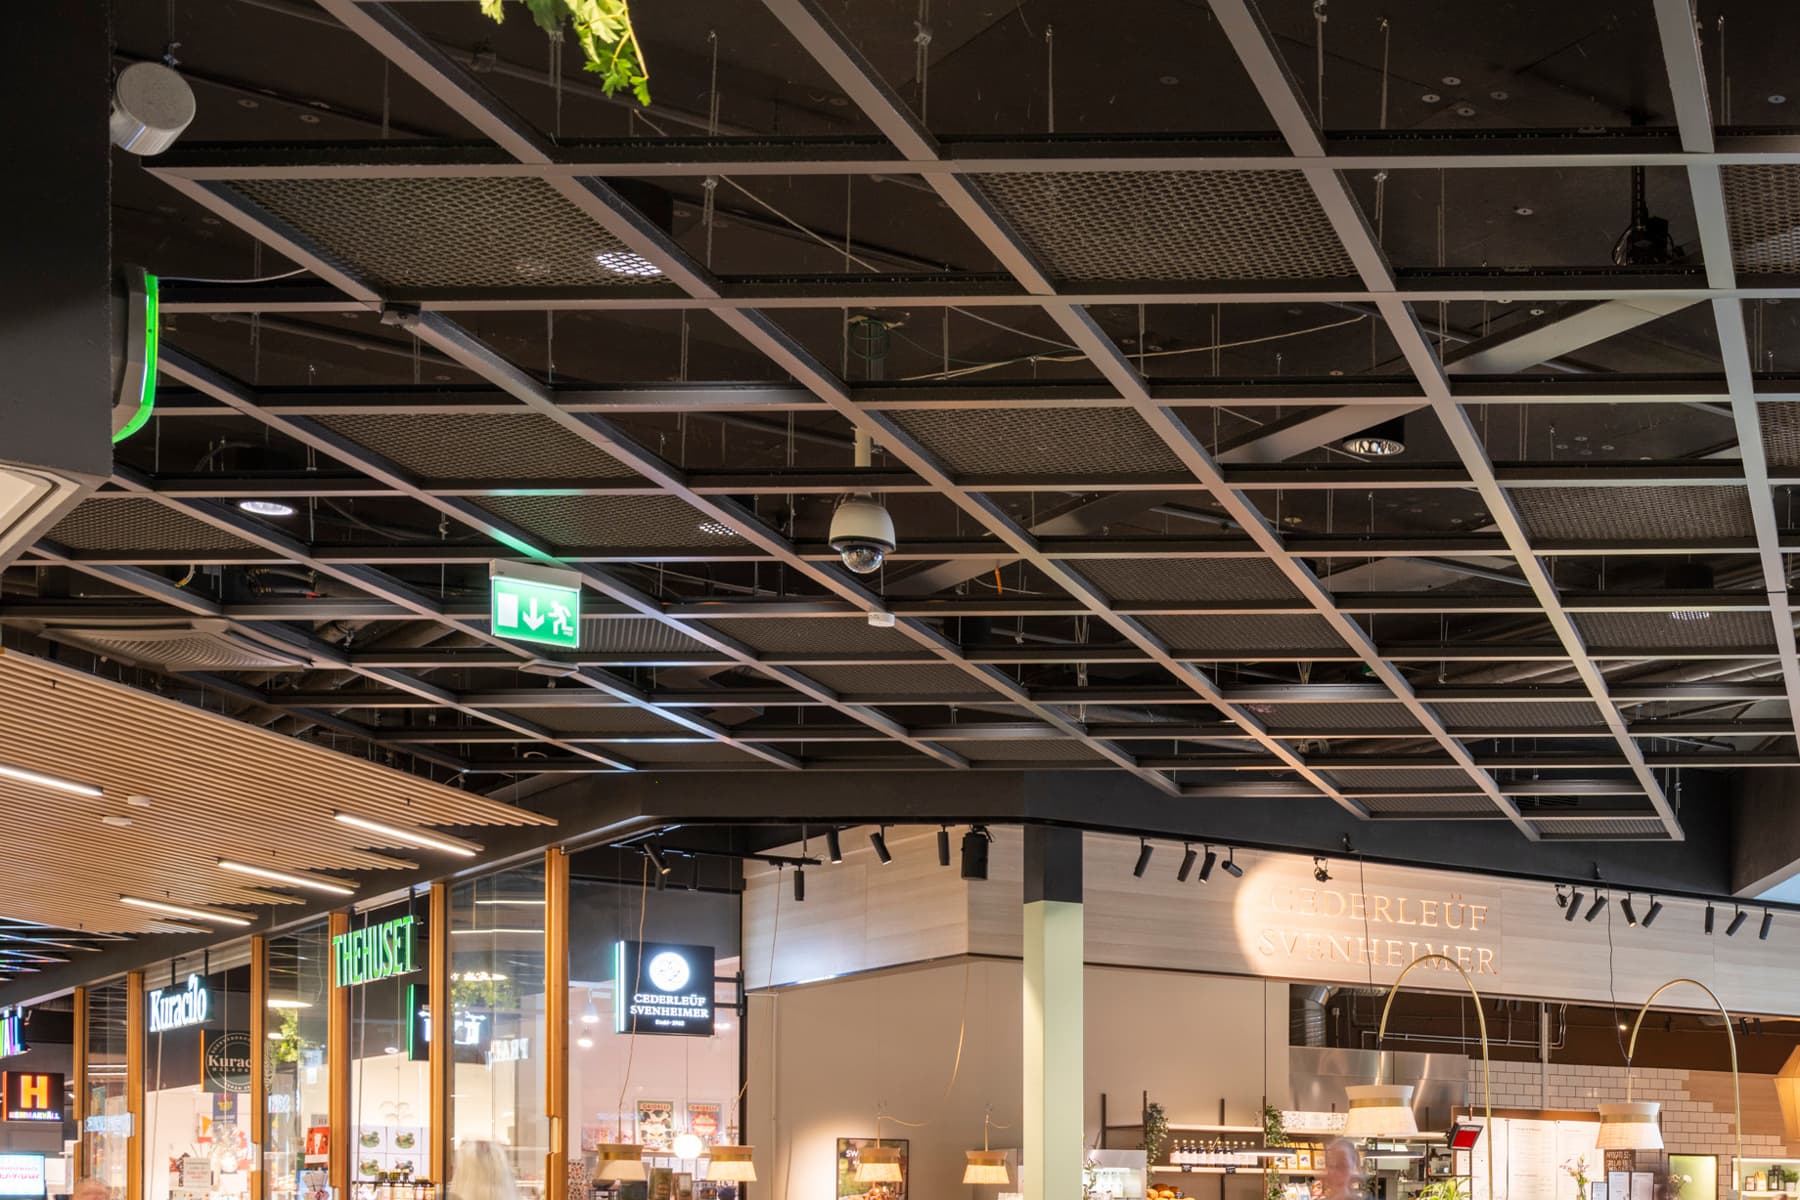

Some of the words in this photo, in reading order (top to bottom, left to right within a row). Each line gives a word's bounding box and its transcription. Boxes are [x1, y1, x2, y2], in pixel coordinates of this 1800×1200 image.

[333, 914, 414, 988] THEHUSET
[1258, 928, 1497, 976] SVENHEIMER
[630, 1005, 709, 1018] SVENHEIMER
[634, 993, 706, 1007] CEDERLEÜF
[21, 1075, 48, 1109] H
